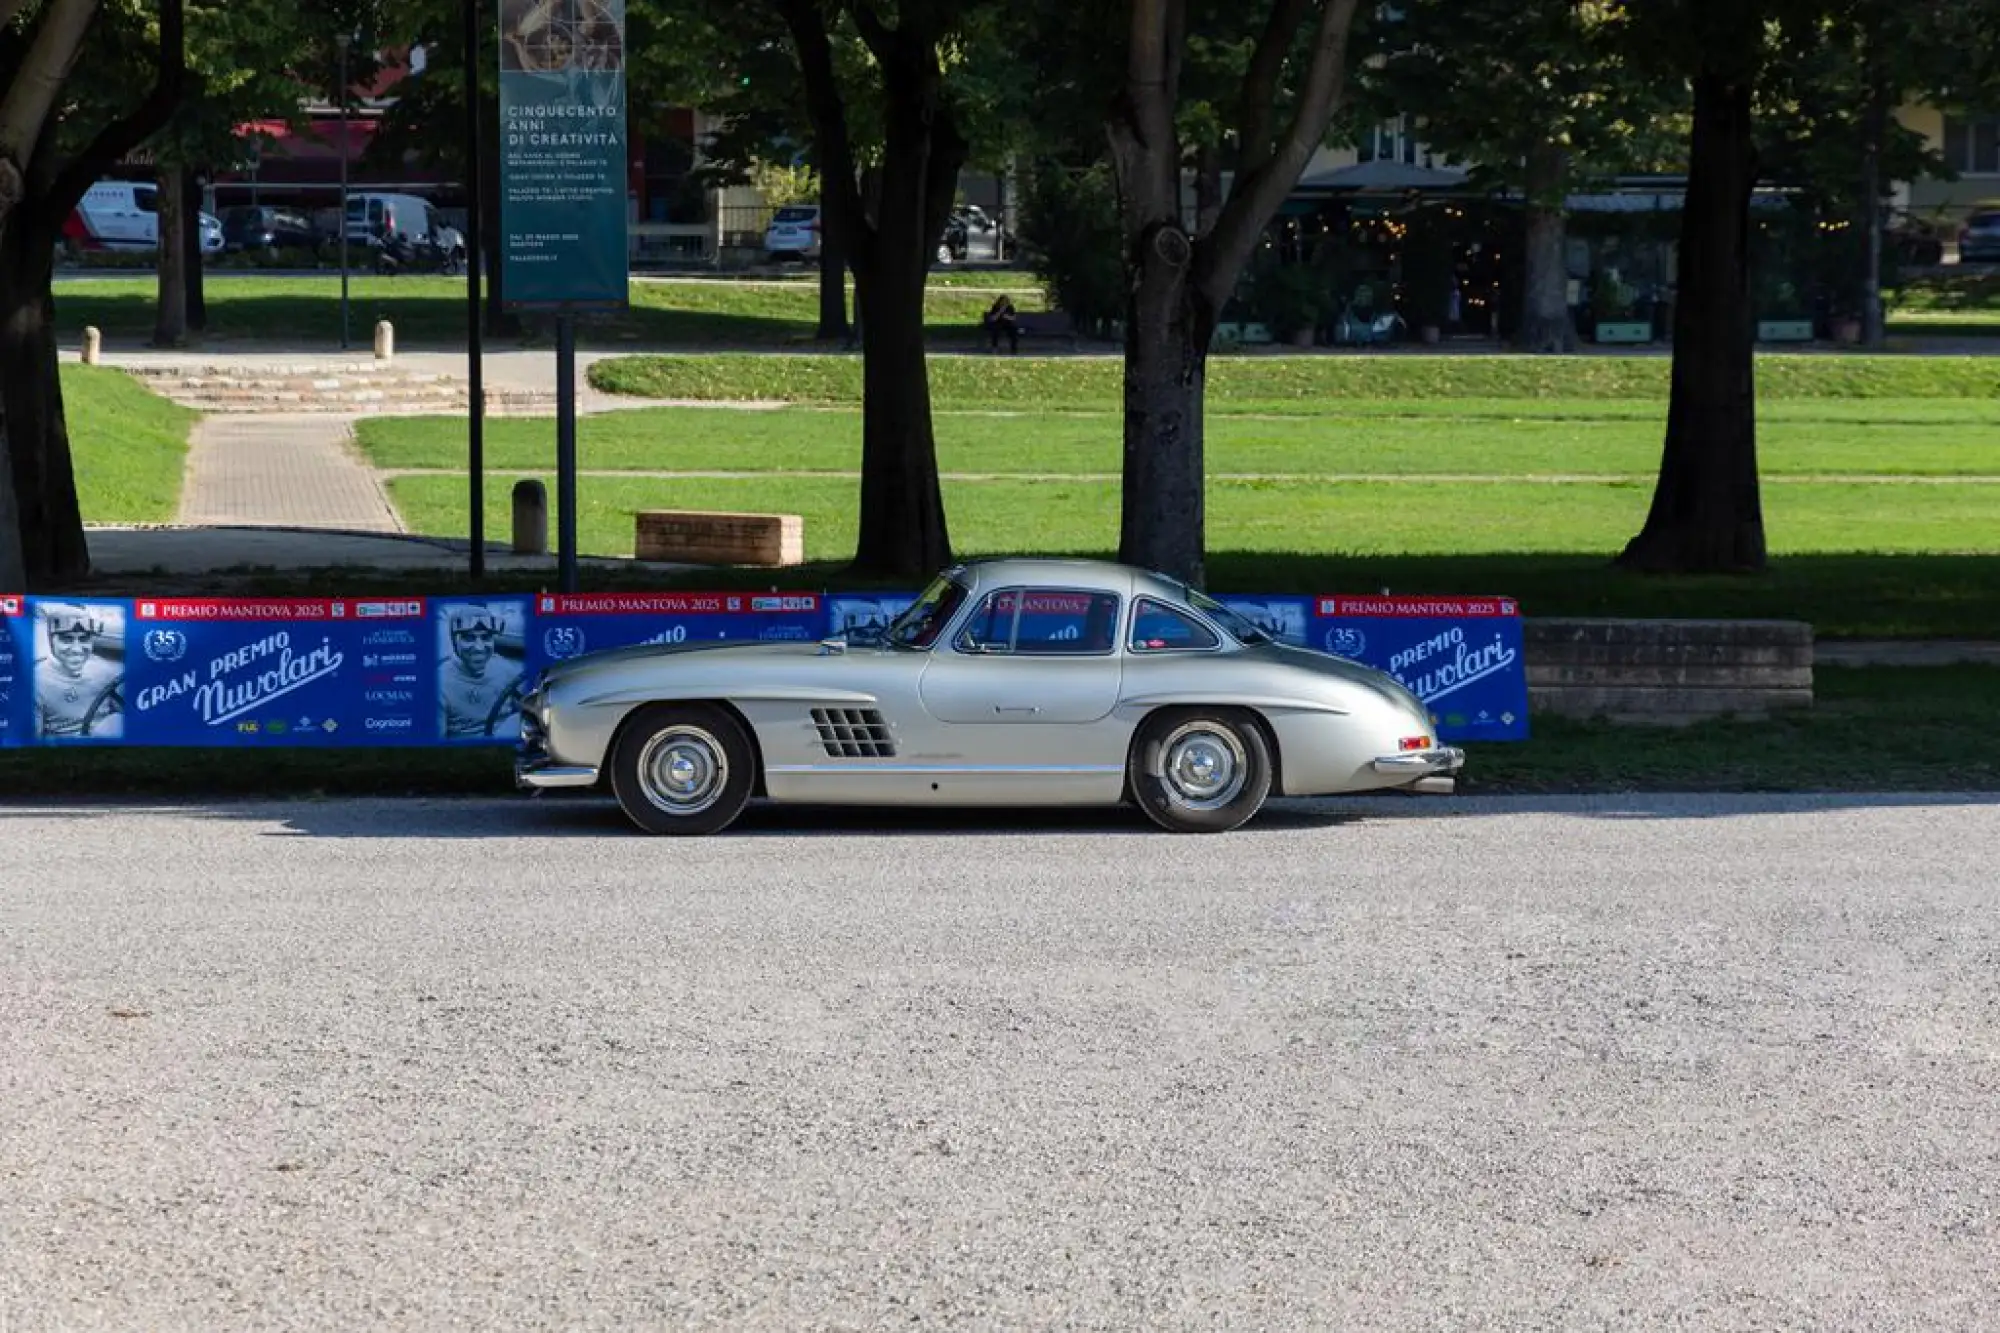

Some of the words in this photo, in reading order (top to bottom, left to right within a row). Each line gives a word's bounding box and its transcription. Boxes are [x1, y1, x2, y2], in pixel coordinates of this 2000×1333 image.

[508, 106, 616, 117] CINQUECENTO
[508, 120, 545, 130] ANNI
[509, 134, 524, 145] DI
[530, 132, 618, 145] CREATIVITÀ
[163, 604, 218, 617] PREMIO
[220, 604, 291, 617] MANTOVA
[295, 605, 325, 616] 2025
[563, 599, 616, 611] PREMIO
[619, 598, 687, 610] MANTOVA
[691, 597, 720, 610] 2025
[1341, 602, 1394, 613] PREMIO
[1396, 602, 1463, 613] MANTOVA
[1468, 603, 1495, 613] 2025
[153, 630, 175, 646] 35
[553, 627, 574, 644] 35
[1335, 628, 1355, 643] 35
[1390, 626, 1463, 672] PREMIO
[136, 670, 196, 710] GRAN
[210, 631, 289, 679] PREMIO
[193, 636, 343, 725] Nuvolari
